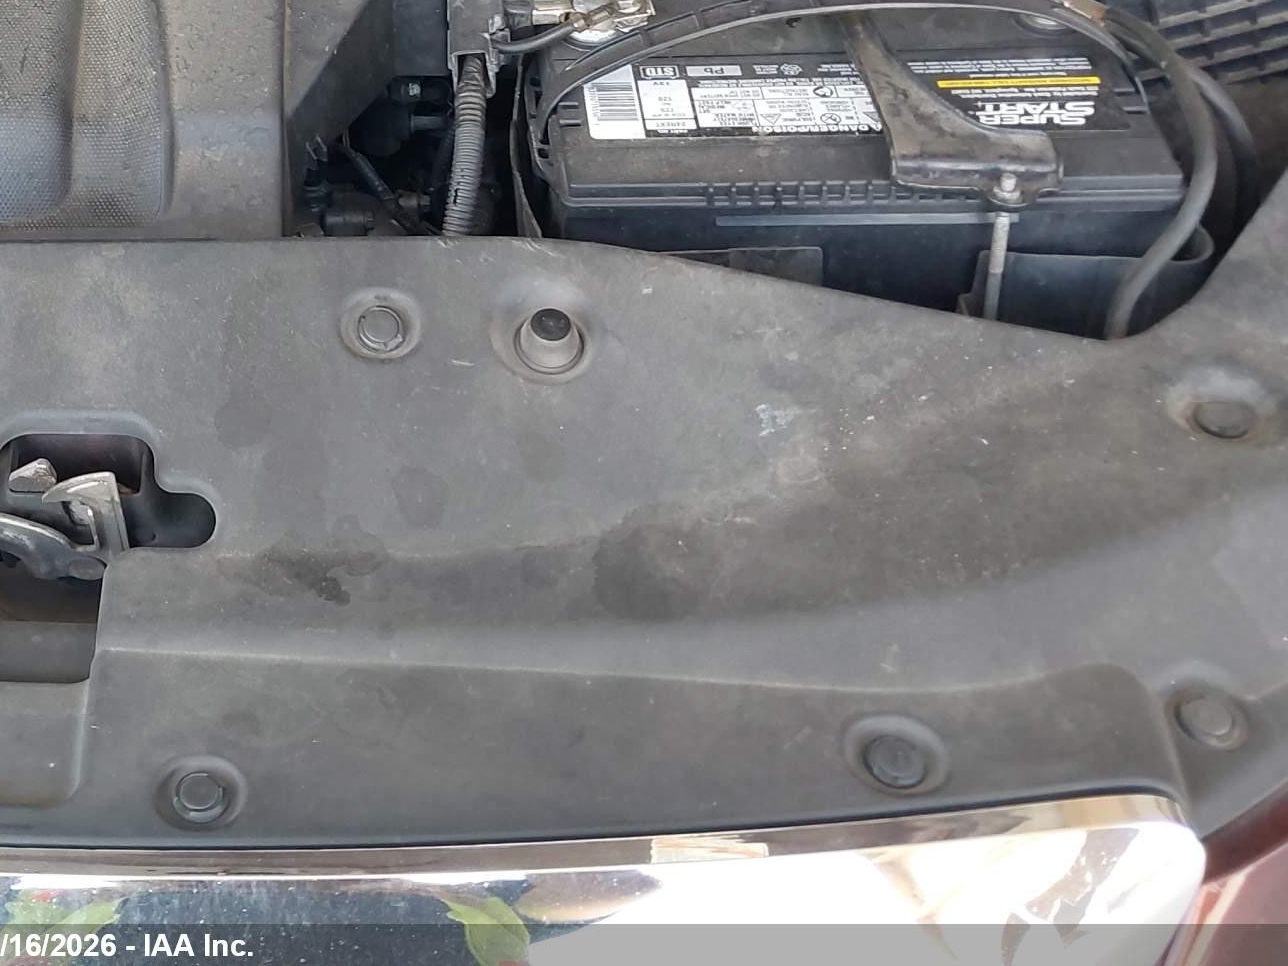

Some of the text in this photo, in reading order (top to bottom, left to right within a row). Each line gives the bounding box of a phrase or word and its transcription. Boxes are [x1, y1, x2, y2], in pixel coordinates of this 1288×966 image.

[645, 67, 674, 76] STD
[703, 67, 725, 75] Pb
[976, 101, 1095, 115] START
[978, 114, 1086, 125] SUPER
